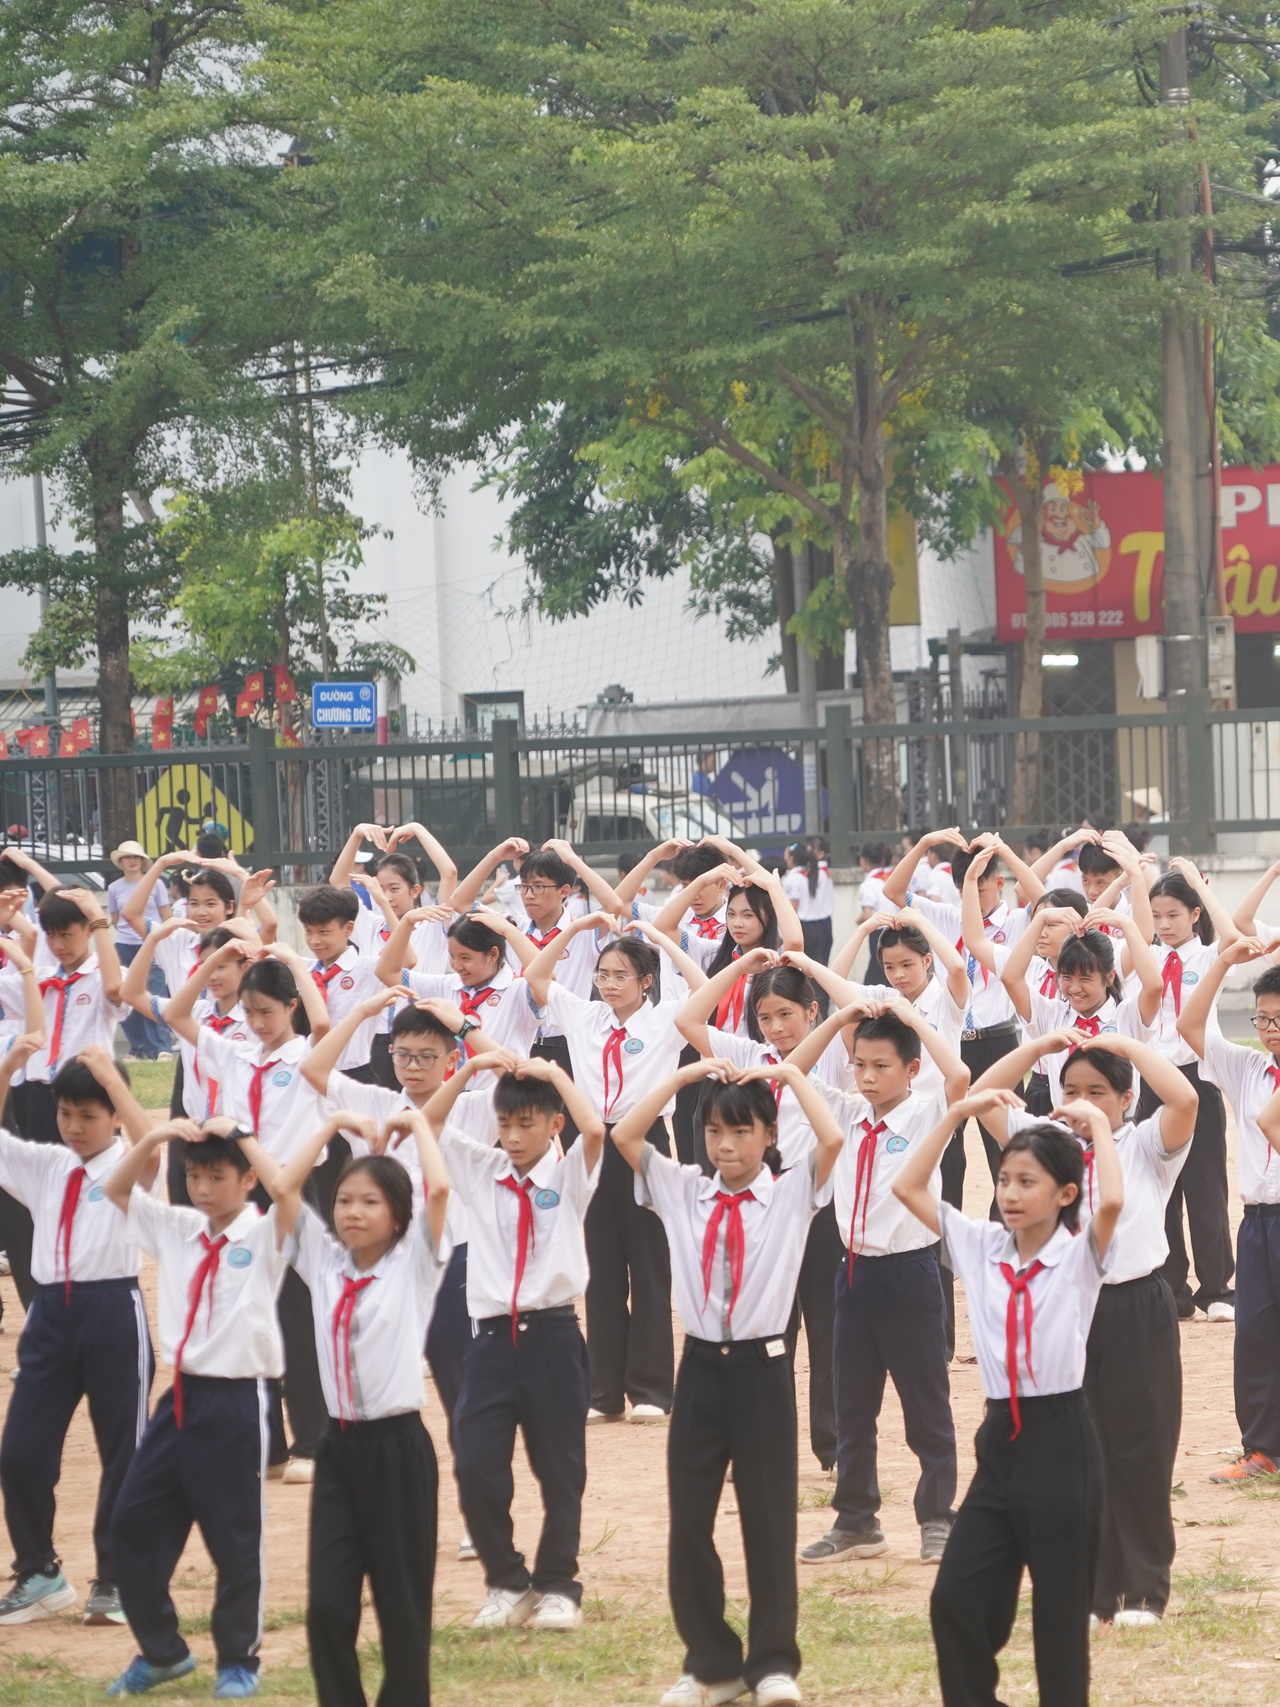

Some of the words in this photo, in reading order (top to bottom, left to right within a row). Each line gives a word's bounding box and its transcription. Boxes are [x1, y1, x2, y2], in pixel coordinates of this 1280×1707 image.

[1098, 610, 1124, 625] 222
[320, 689, 353, 702] ĐƯỜNG
[317, 707, 351, 722] CHƯƠNG
[353, 705, 371, 722] ĐỨC
